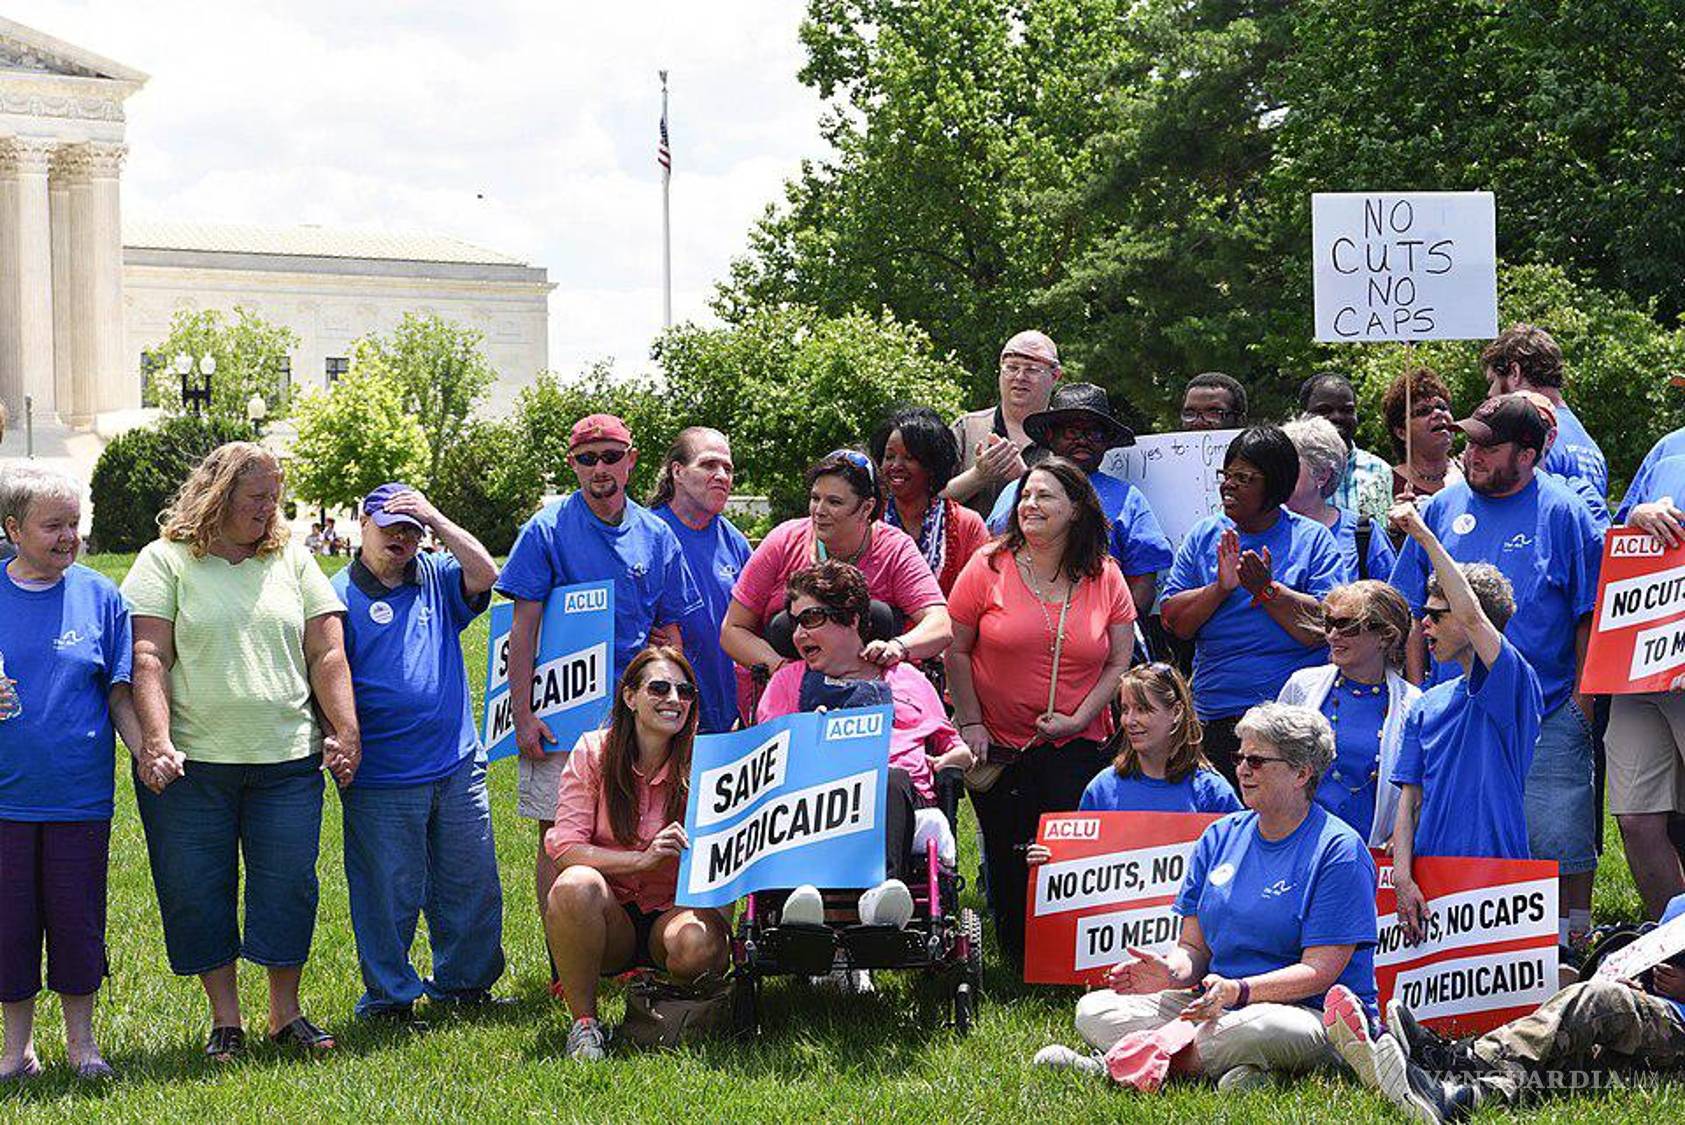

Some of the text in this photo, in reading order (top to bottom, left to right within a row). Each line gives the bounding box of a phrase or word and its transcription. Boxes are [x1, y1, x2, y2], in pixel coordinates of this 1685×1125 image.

[1365, 199, 1414, 238] NO
[1332, 237, 1455, 274] CUTS
[1368, 276, 1416, 307] NO
[1333, 307, 1436, 337] CAPS
[1613, 537, 1662, 554] ACLU
[566, 590, 605, 611] ACLU
[1611, 576, 1685, 619] NO CUT
[1644, 636, 1667, 666] TO
[829, 716, 880, 738] ACLU
[712, 742, 780, 814] SAVE
[708, 782, 862, 883] MEDICAID!
[1047, 821, 1097, 838] ACLU
[1046, 854, 1185, 902] NO CUTS, NO
[1087, 915, 1184, 956] TO MEDI
[1375, 925, 1402, 955] NO
[1446, 903, 1475, 937] NO
[1479, 891, 1545, 930] CAPS
[1402, 959, 1545, 1010] TO MEDICAID!
